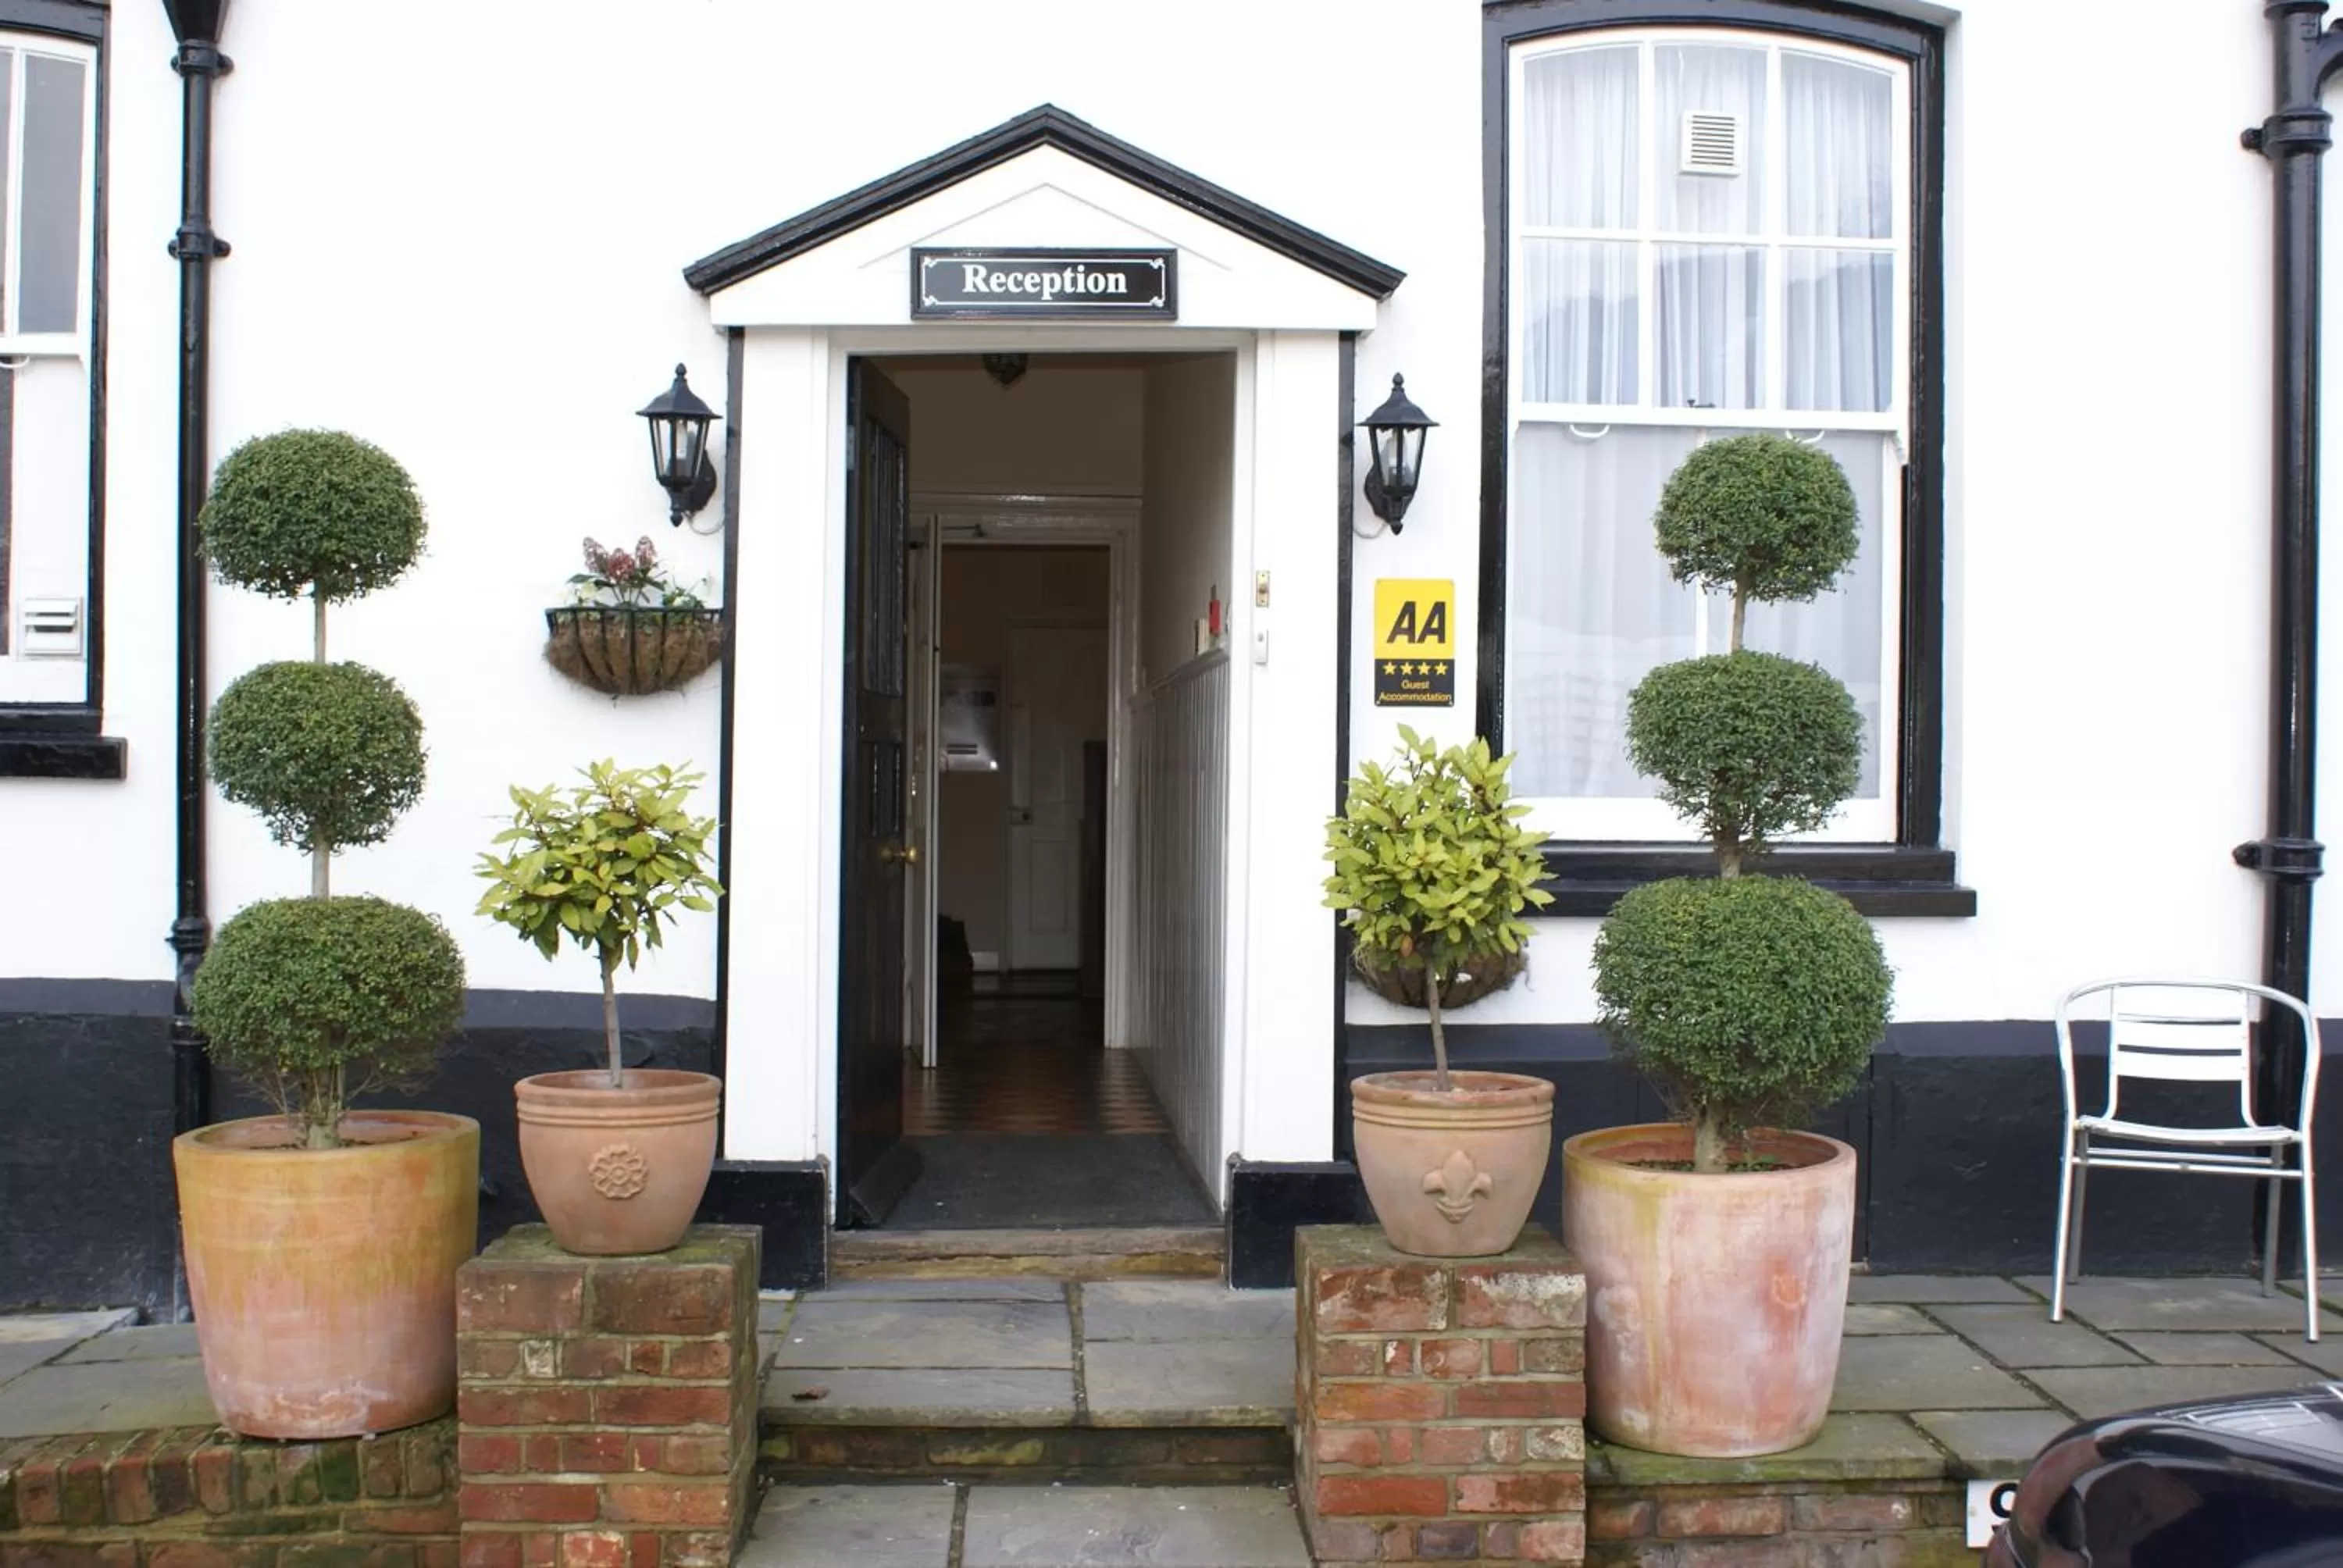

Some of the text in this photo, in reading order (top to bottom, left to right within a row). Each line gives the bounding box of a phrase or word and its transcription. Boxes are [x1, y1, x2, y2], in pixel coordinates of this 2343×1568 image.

[961, 264, 1128, 301] Reception
[1385, 600, 1446, 644] AA
[1379, 692, 1452, 701] Accommodation
[1401, 679, 1430, 690] Guest
